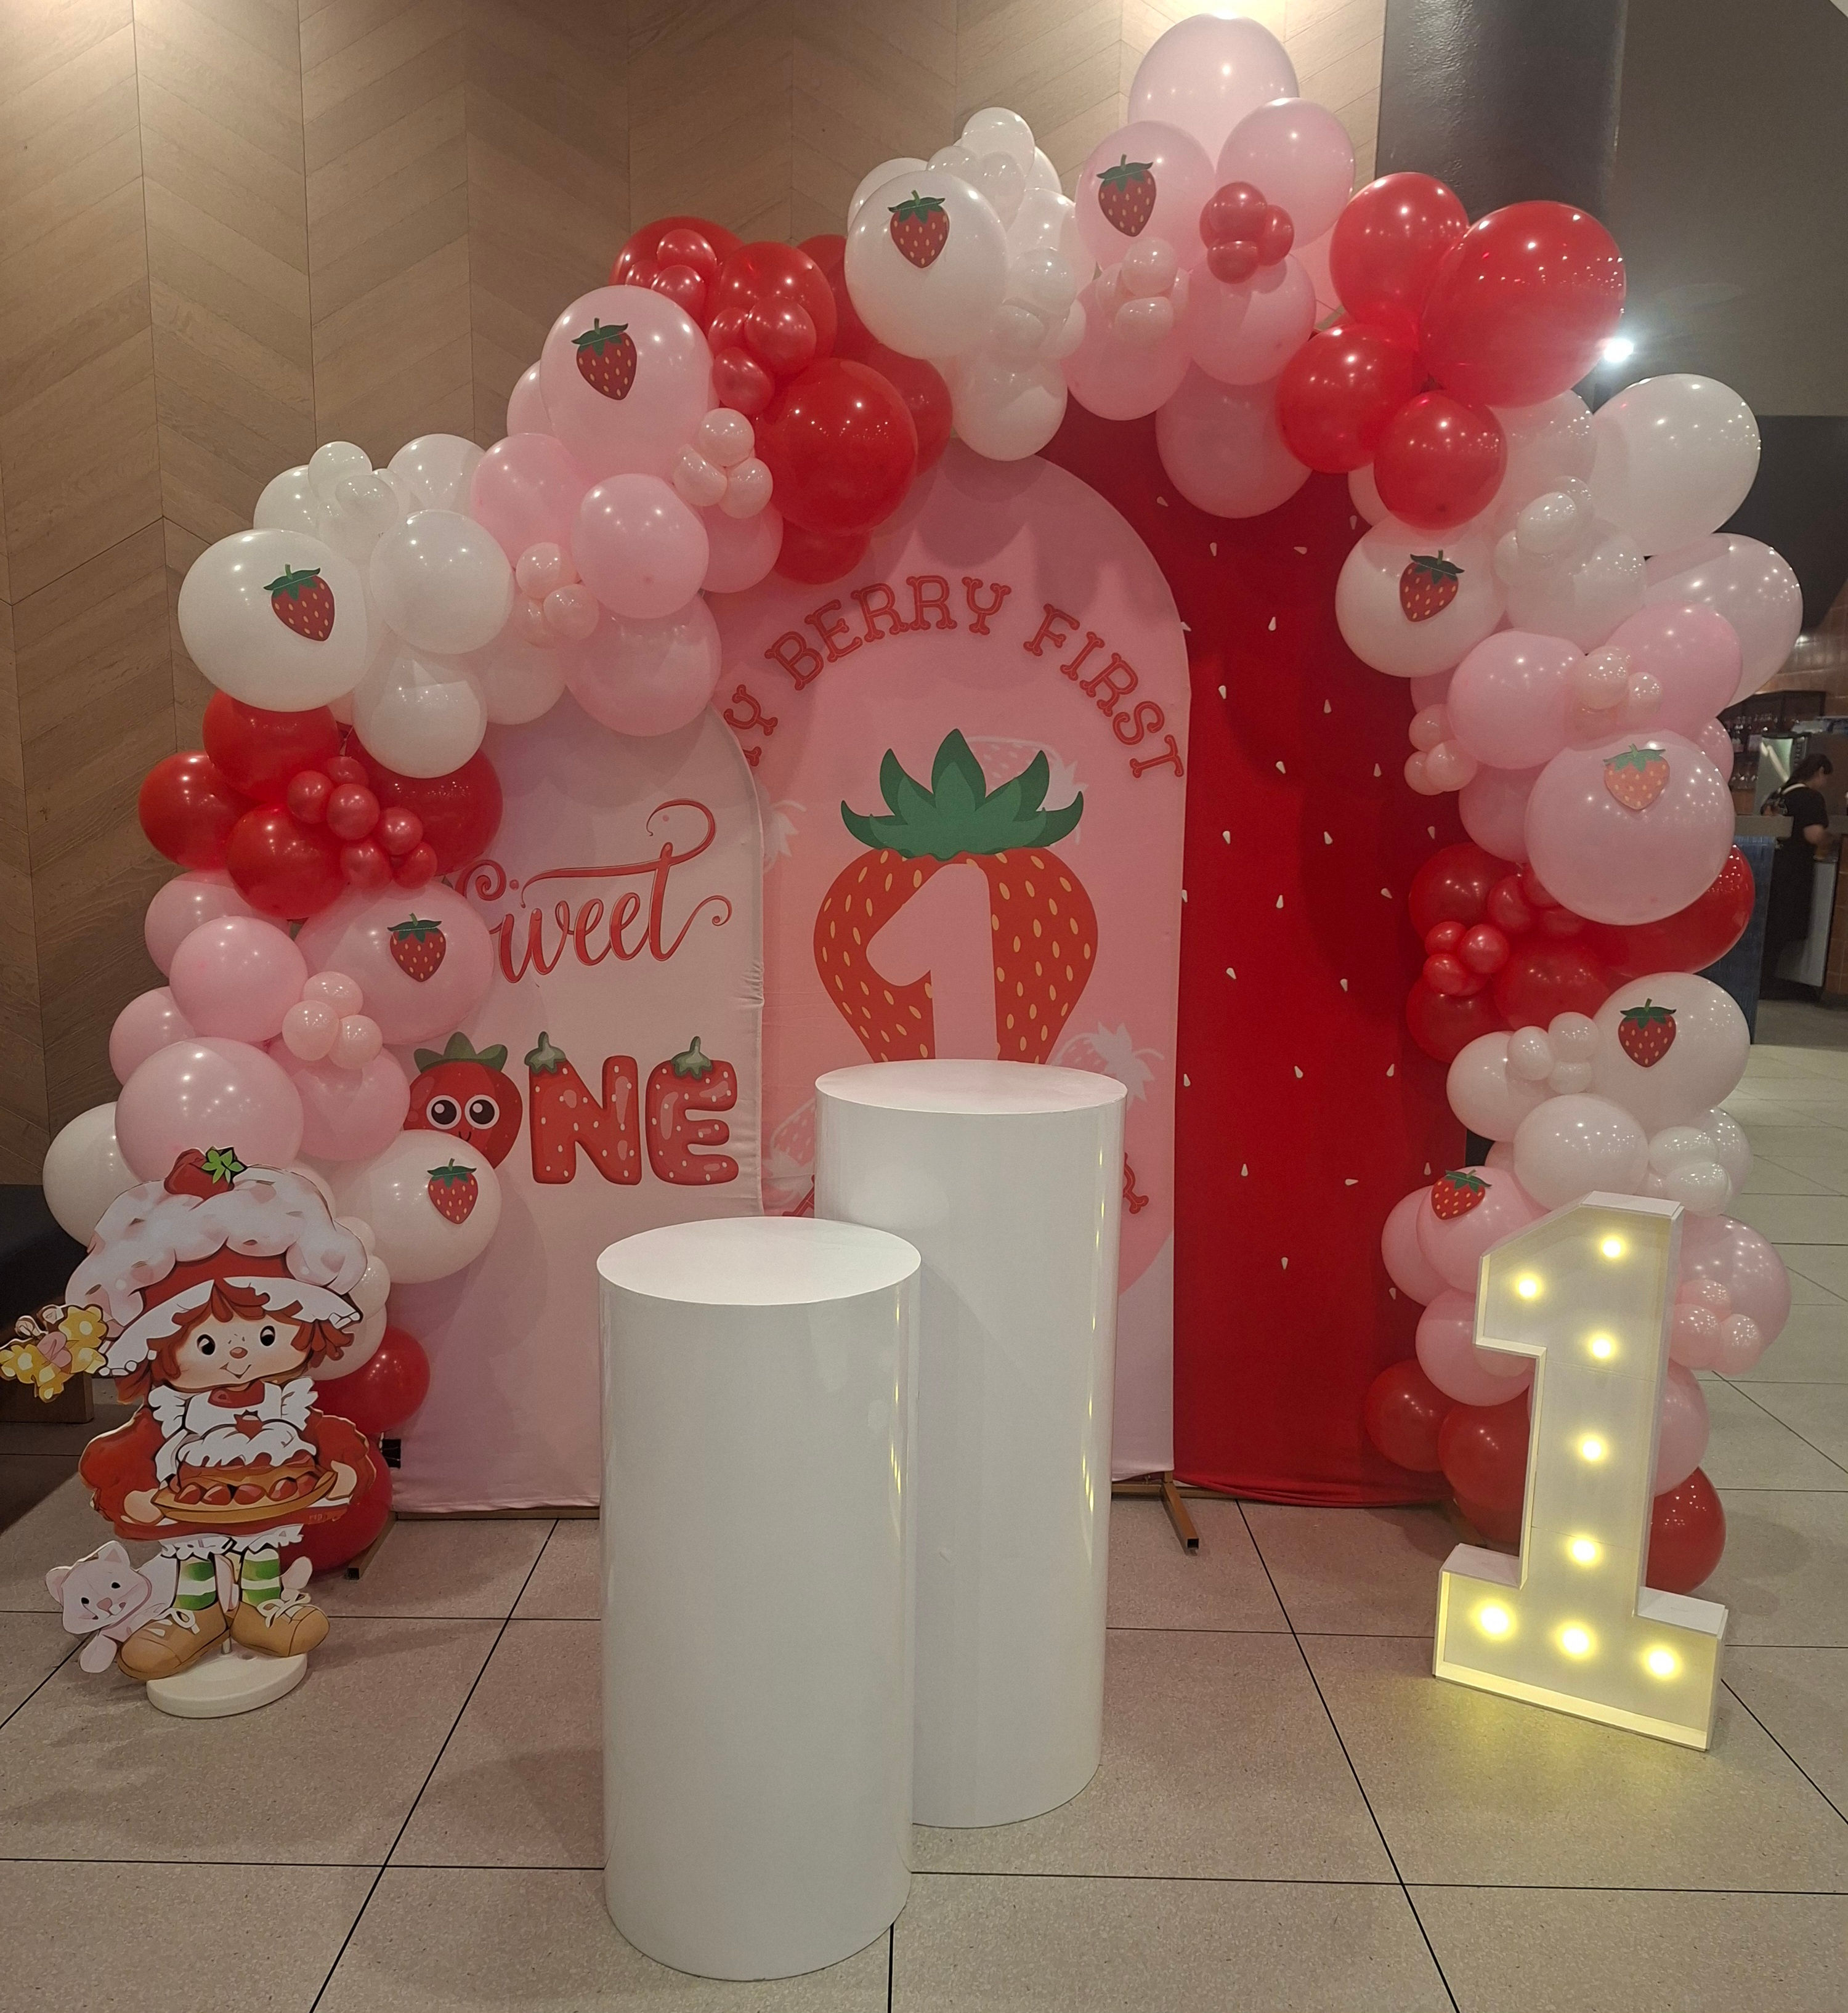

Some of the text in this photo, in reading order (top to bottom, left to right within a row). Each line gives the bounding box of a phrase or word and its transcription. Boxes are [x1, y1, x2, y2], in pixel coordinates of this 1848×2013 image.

[764, 575, 1011, 691] BERRY
[1023, 603, 1184, 779] FIRST
[1434, 1191, 1727, 1751] 1
